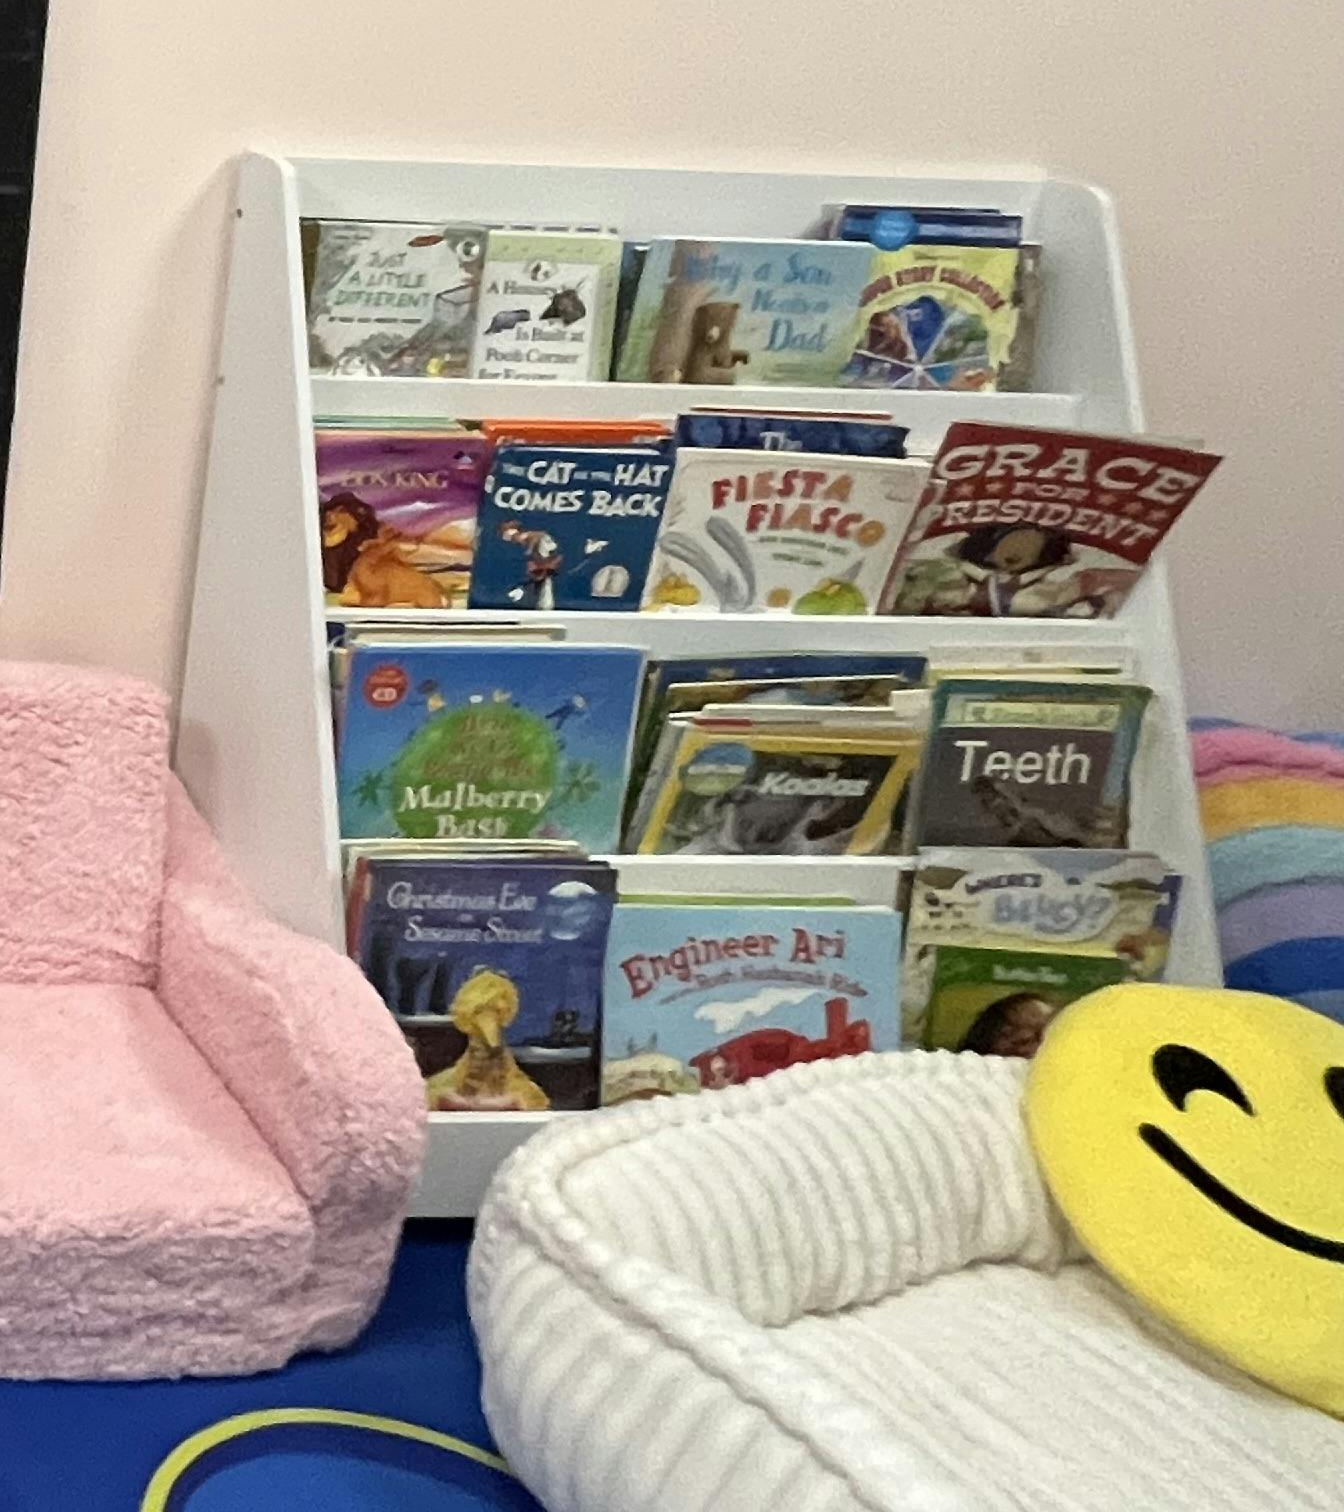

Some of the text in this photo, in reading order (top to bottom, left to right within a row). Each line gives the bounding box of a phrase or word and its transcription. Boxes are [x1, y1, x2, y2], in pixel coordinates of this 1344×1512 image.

[527, 460, 669, 486] CAT HAT
[712, 469, 854, 509] FIESTA
[936, 443, 1205, 504] GRACE
[1012, 482, 1092, 501] FOR
[494, 487, 661, 517] COMES BACK
[746, 503, 886, 547] FIASCO
[954, 740, 1091, 784] Teeth
[619, 934, 780, 999] Engineer
[791, 928, 846, 964] Ari
